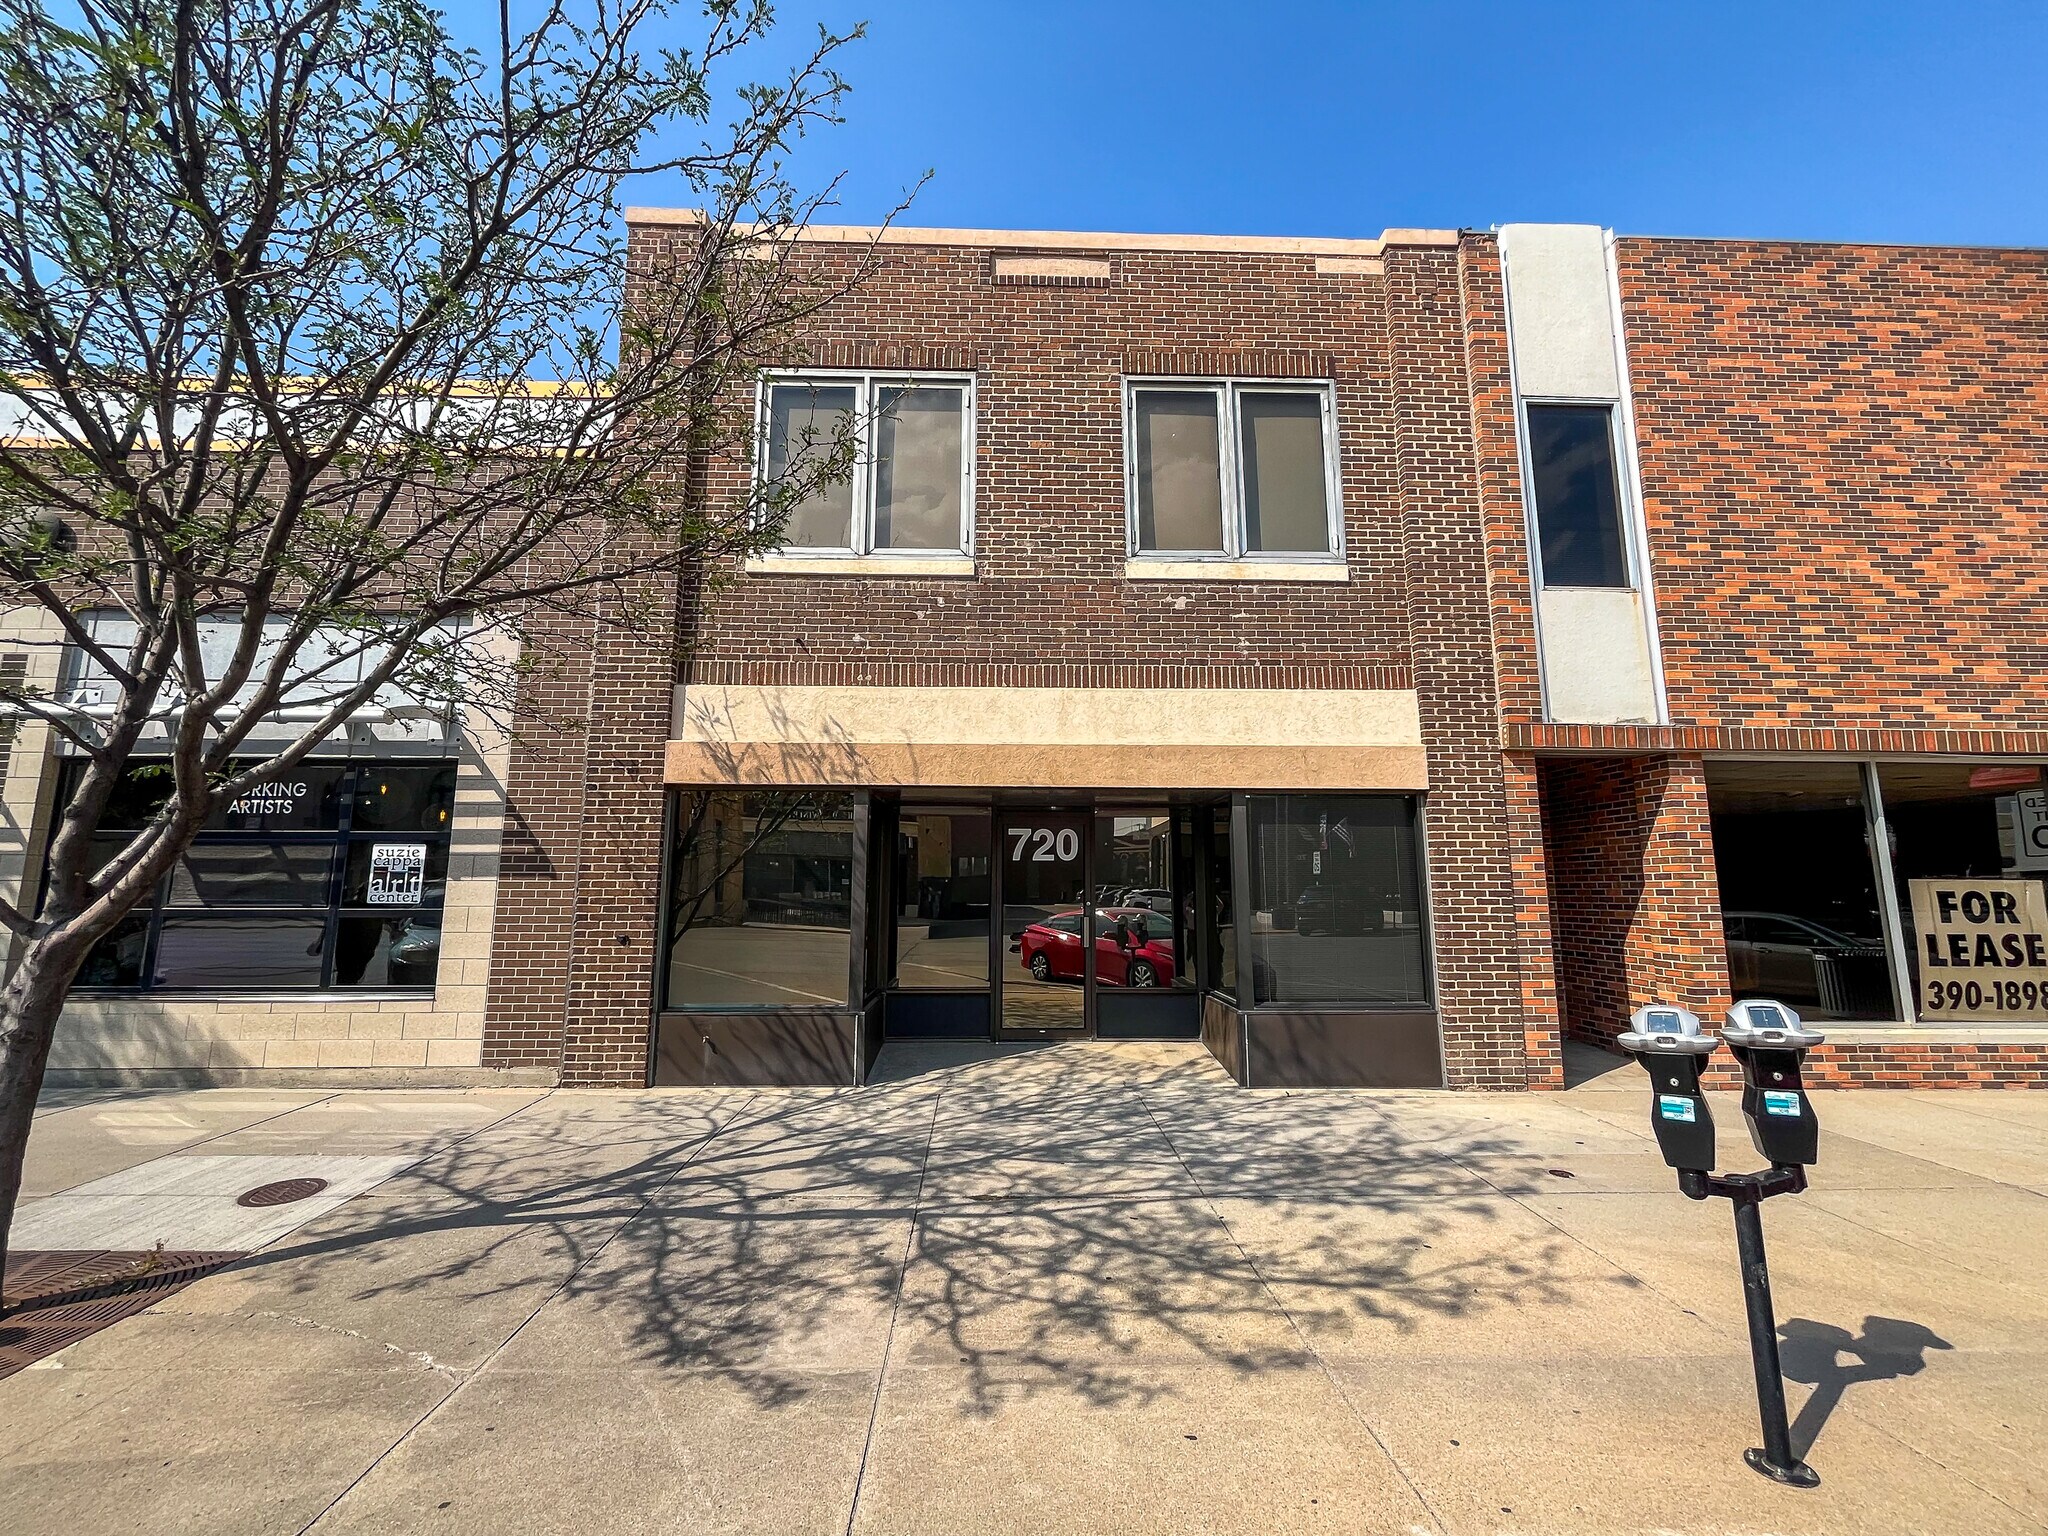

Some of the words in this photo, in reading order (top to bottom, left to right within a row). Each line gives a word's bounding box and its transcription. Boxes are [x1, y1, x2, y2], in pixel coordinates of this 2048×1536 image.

[241, 782, 307, 797] RKING
[226, 799, 294, 814] ARTISTS
[377, 845, 420, 858] suzie
[1008, 828, 1079, 862] 720
[373, 857, 421, 871] cappa
[369, 893, 418, 903] center
[1936, 890, 2021, 924] FOR
[1925, 933, 2048, 967] LEASE
